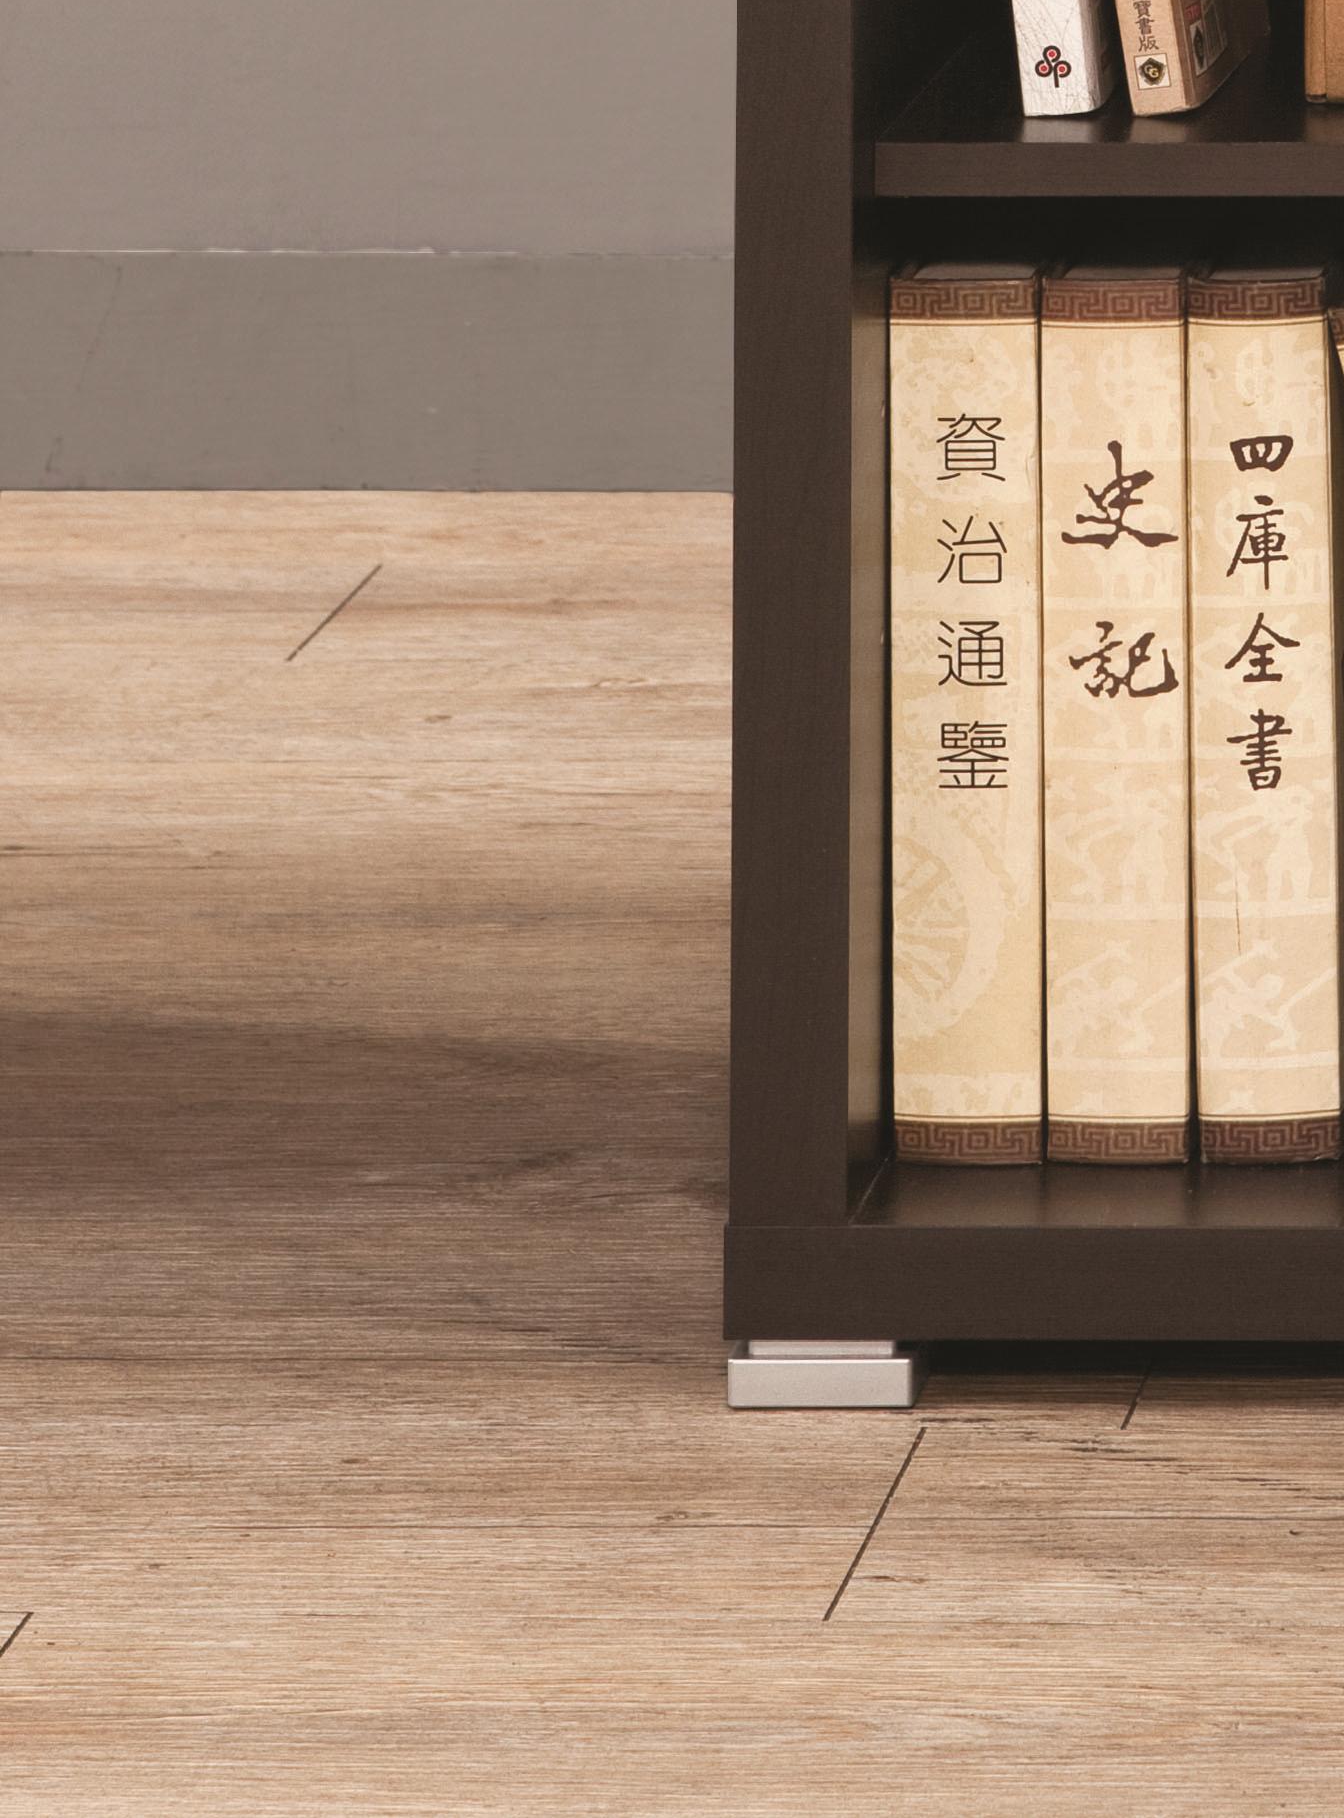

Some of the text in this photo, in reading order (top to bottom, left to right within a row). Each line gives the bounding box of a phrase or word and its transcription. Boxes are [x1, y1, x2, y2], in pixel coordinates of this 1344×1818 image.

[1061, 440, 1180, 699] 史記
[1225, 434, 1301, 791] 四庫全書
